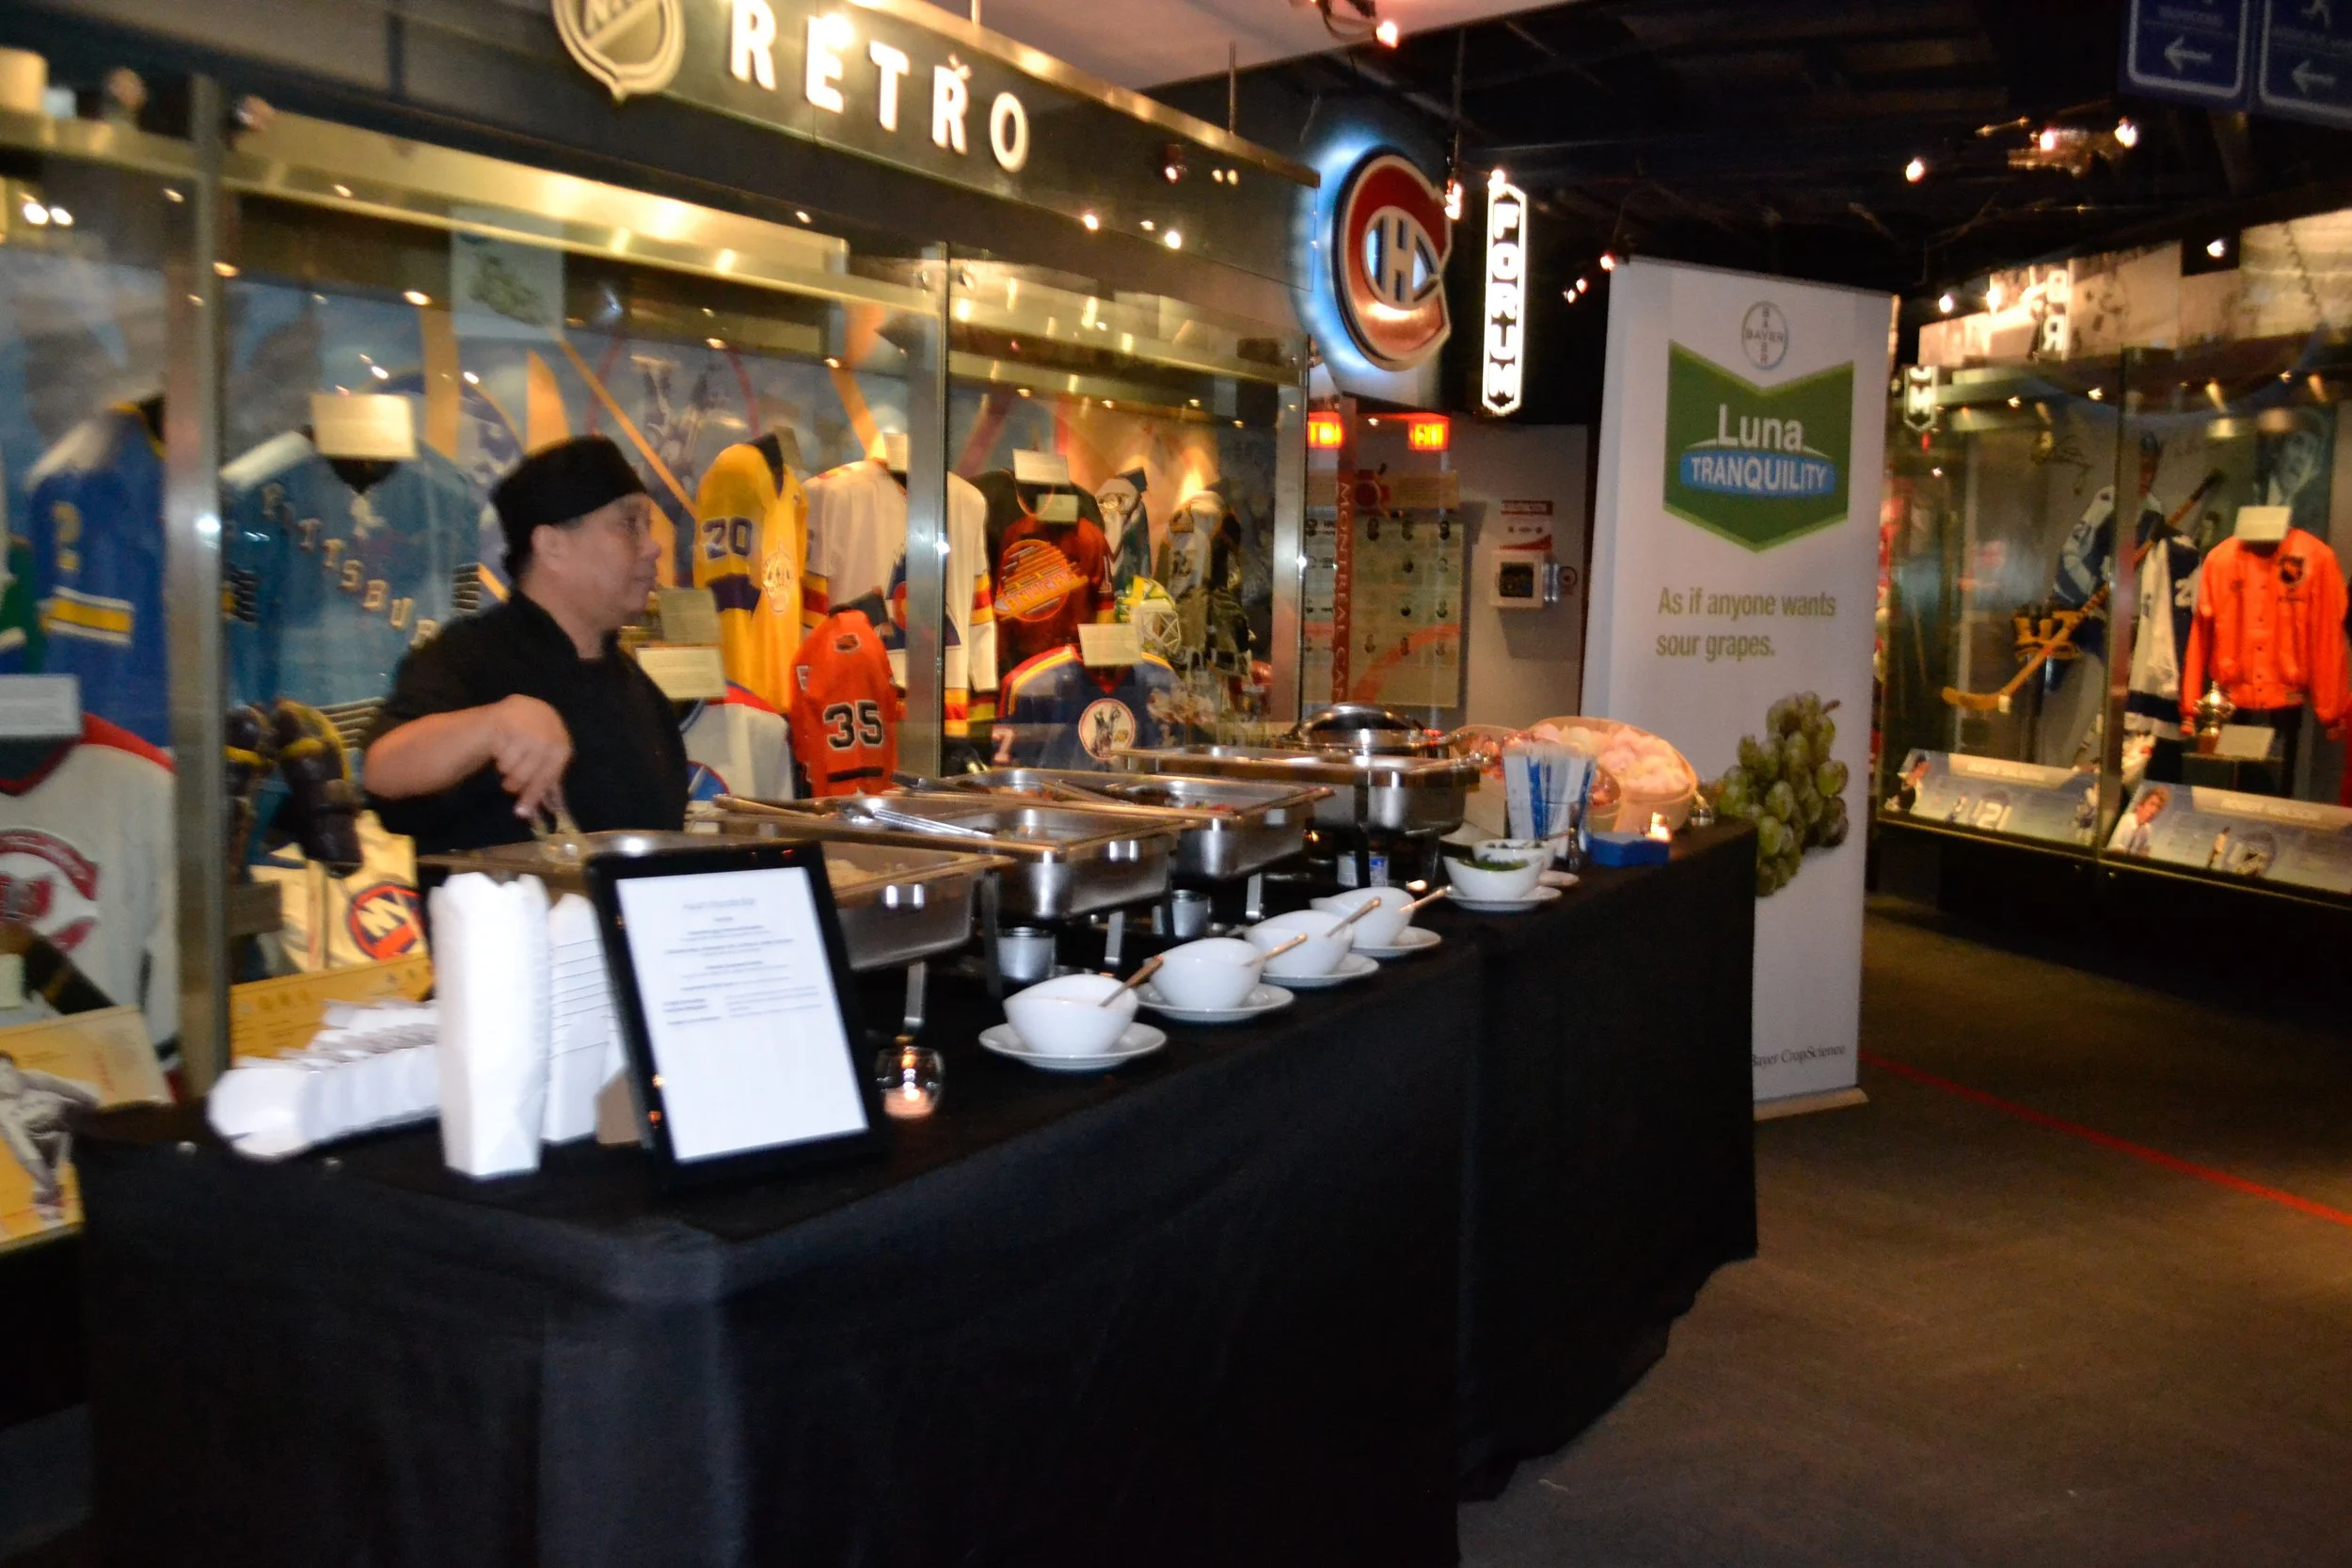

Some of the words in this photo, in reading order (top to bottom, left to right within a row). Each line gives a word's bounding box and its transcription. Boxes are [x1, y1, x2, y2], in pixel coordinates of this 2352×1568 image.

[729, 0, 1031, 173] RETRO
[1489, 201, 1520, 399] FORUM
[1409, 422, 1447, 447] EXIT
[1717, 403, 1804, 451] Luna
[1691, 455, 1828, 491] TRANQUILITY
[703, 517, 754, 559] 20
[1335, 481, 1352, 637] MONTREAL
[1658, 587, 1683, 614] As
[1689, 587, 1704, 612] if
[1707, 591, 1776, 621] anyone
[1781, 591, 1837, 617] wants
[1656, 634, 1700, 657] sour
[1705, 633, 1775, 662] grapes.
[822, 700, 884, 752] 35
[1781, 1045, 1846, 1065] CropScience
